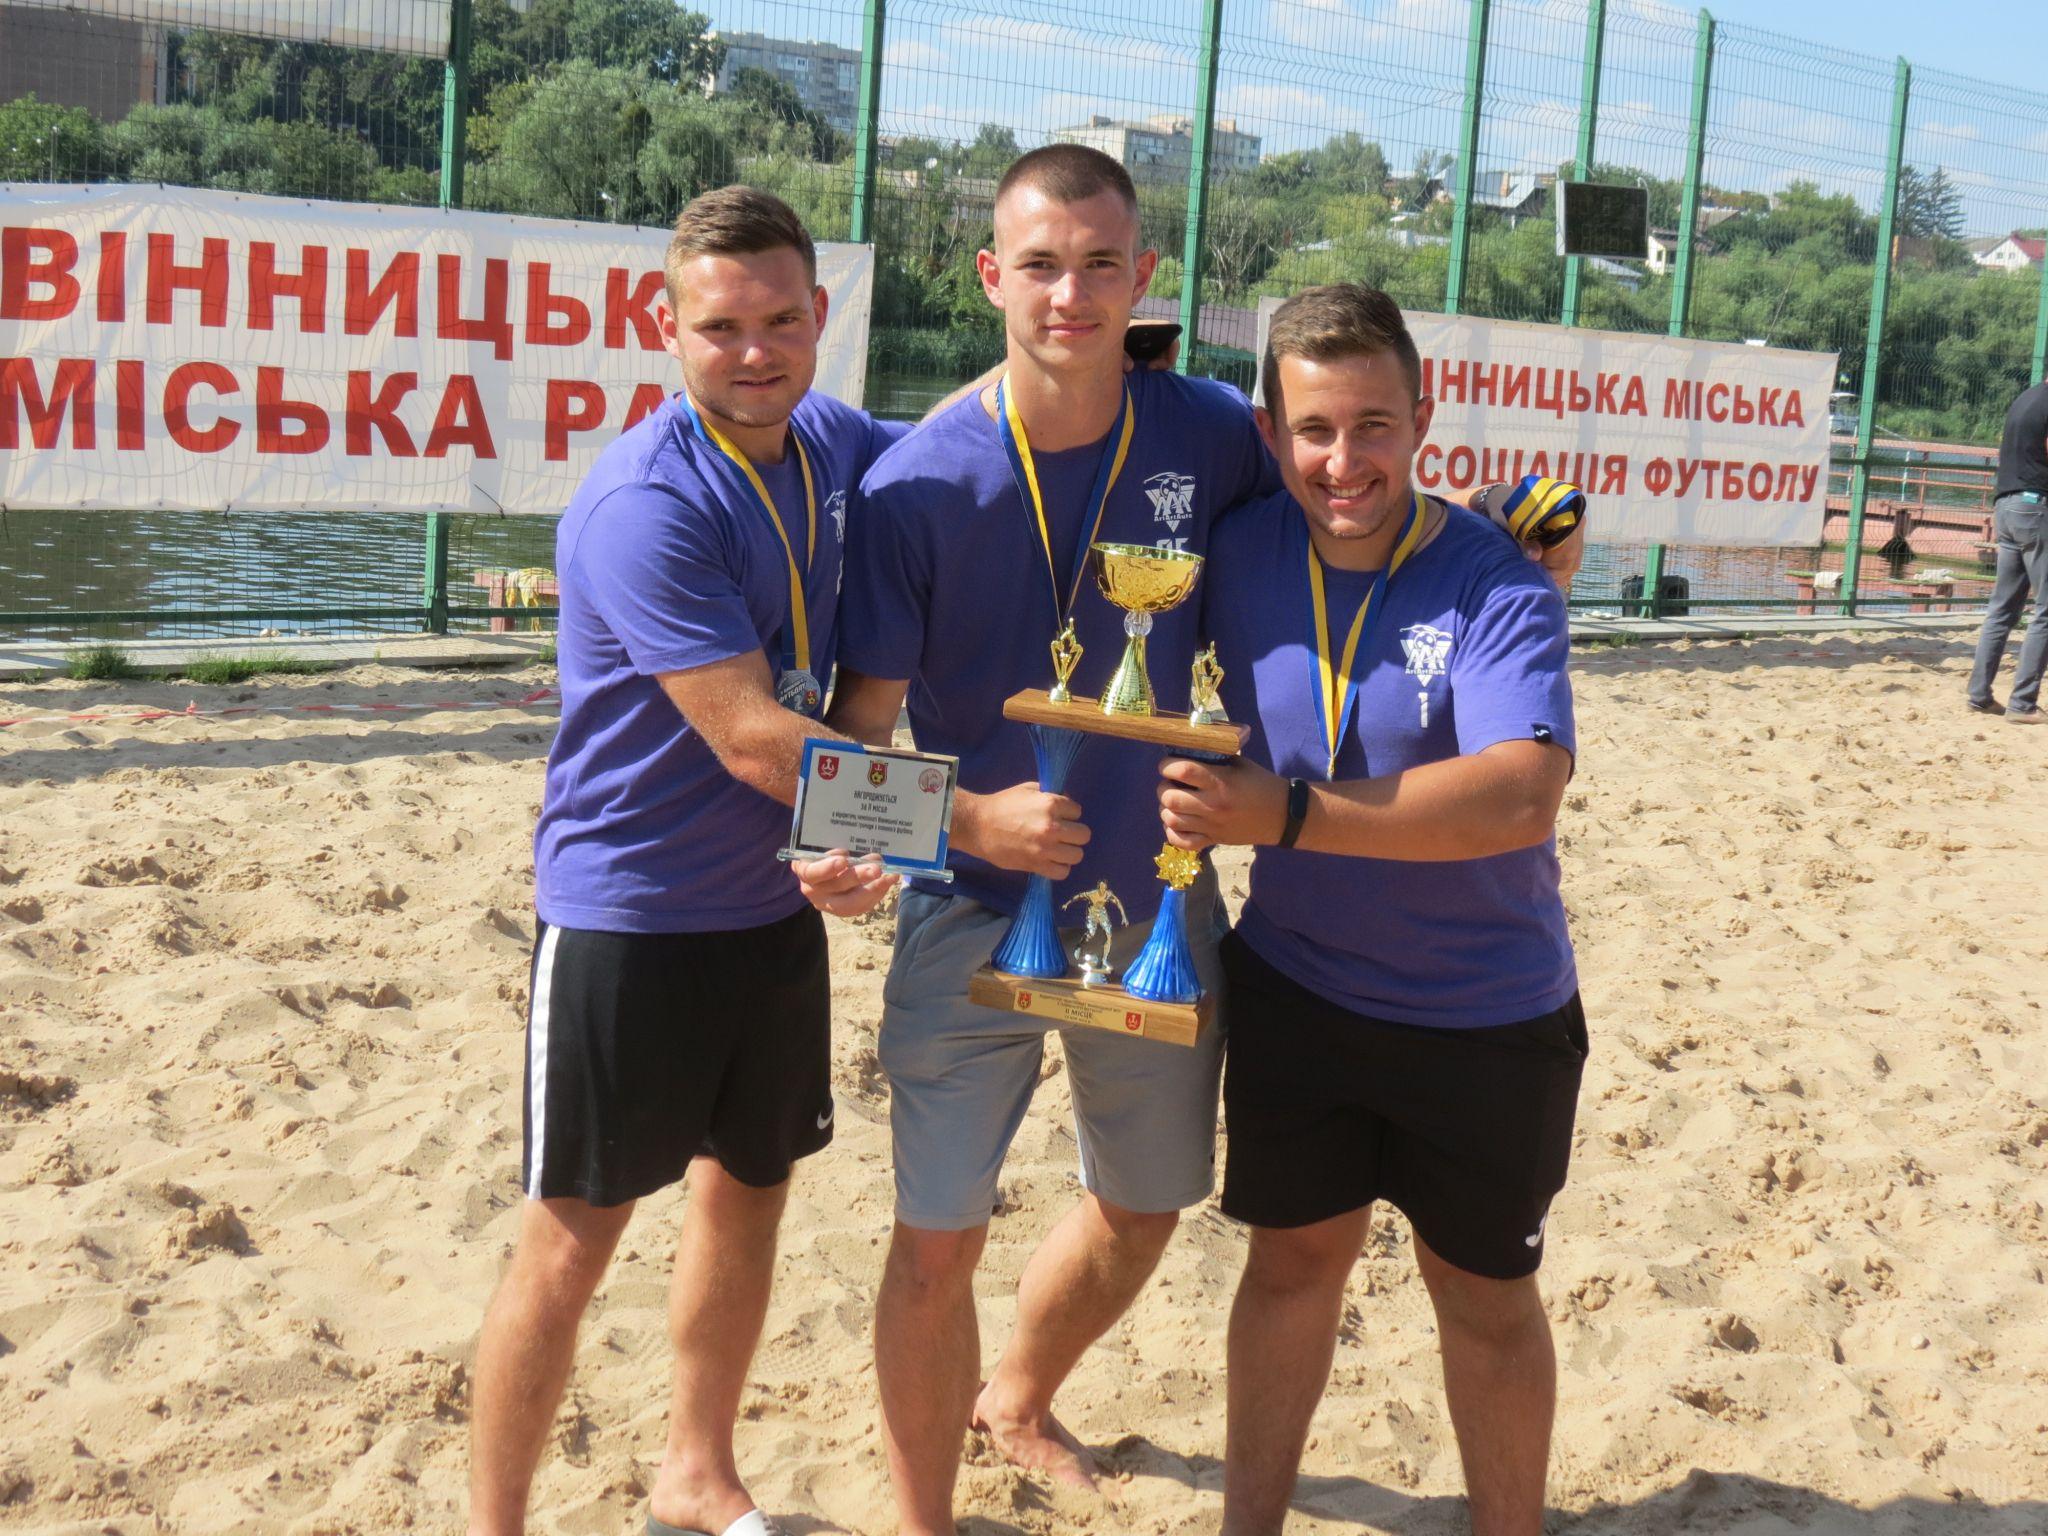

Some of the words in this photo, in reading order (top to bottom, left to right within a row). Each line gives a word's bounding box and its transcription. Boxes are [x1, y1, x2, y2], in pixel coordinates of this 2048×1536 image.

[0, 357, 498, 459] МІСЬКА
[1422, 358, 1648, 420] ІННИЦЬКА
[1663, 378, 1806, 428] МІСЬКА
[1644, 457, 1820, 503] ФУТБОЛУ
[1418, 692, 1428, 728] 1
